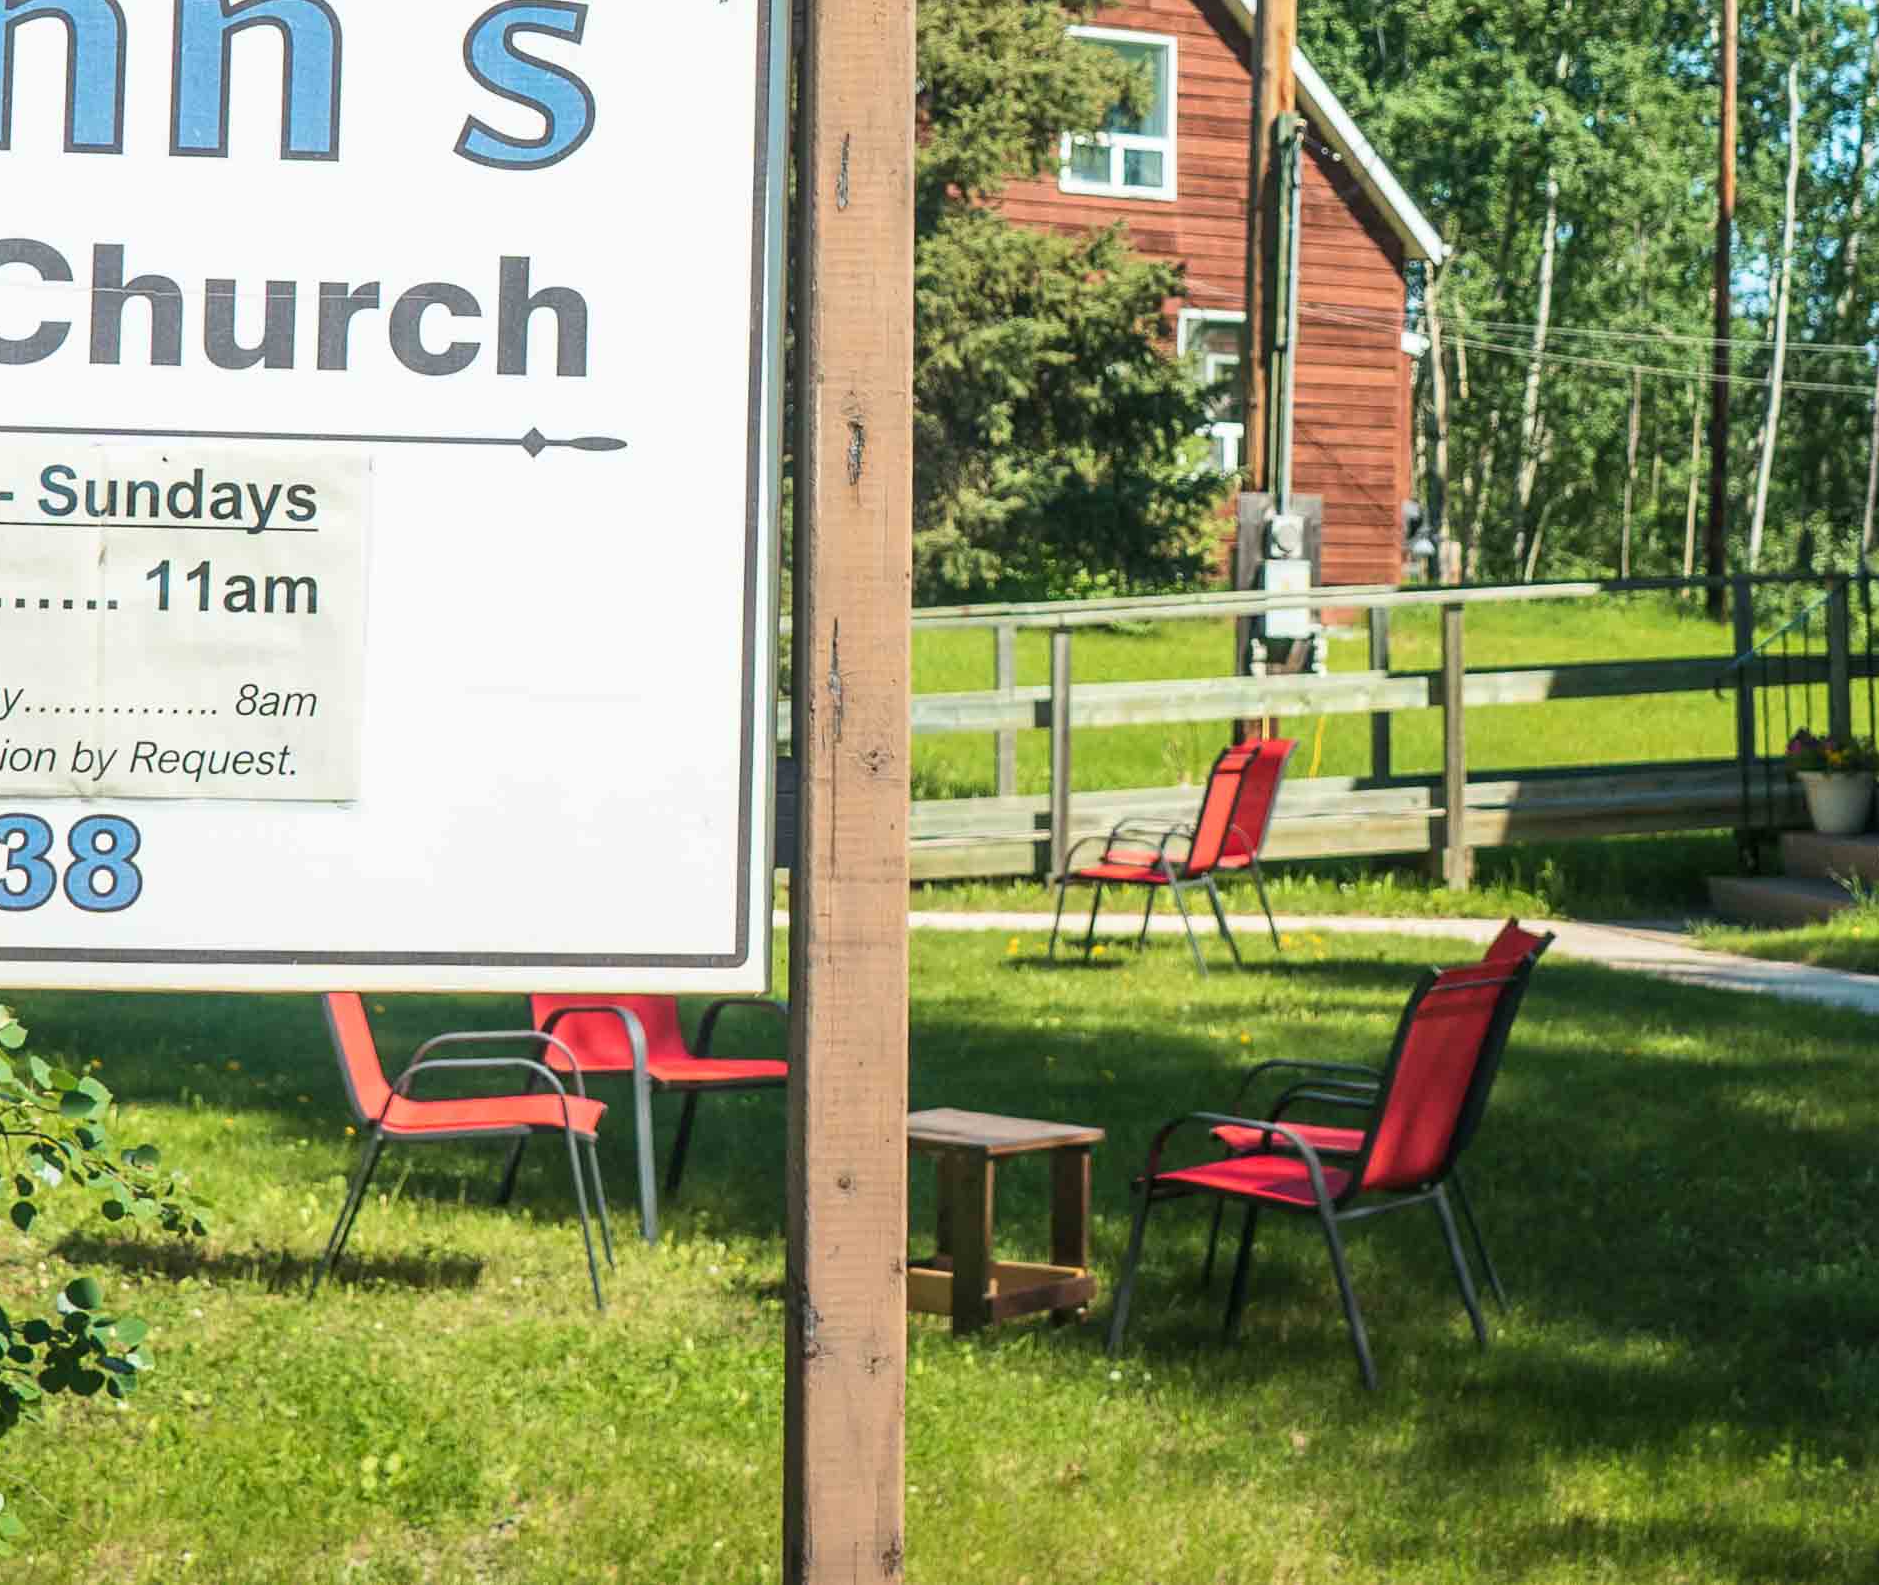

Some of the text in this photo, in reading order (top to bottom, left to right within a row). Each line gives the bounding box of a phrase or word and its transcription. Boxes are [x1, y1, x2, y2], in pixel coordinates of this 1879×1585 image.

[35, 465, 319, 534] Sundays
[146, 559, 318, 615] 11am
[235, 683, 317, 717] 8am
[70, 740, 118, 782] by
[129, 741, 296, 783] Request.
